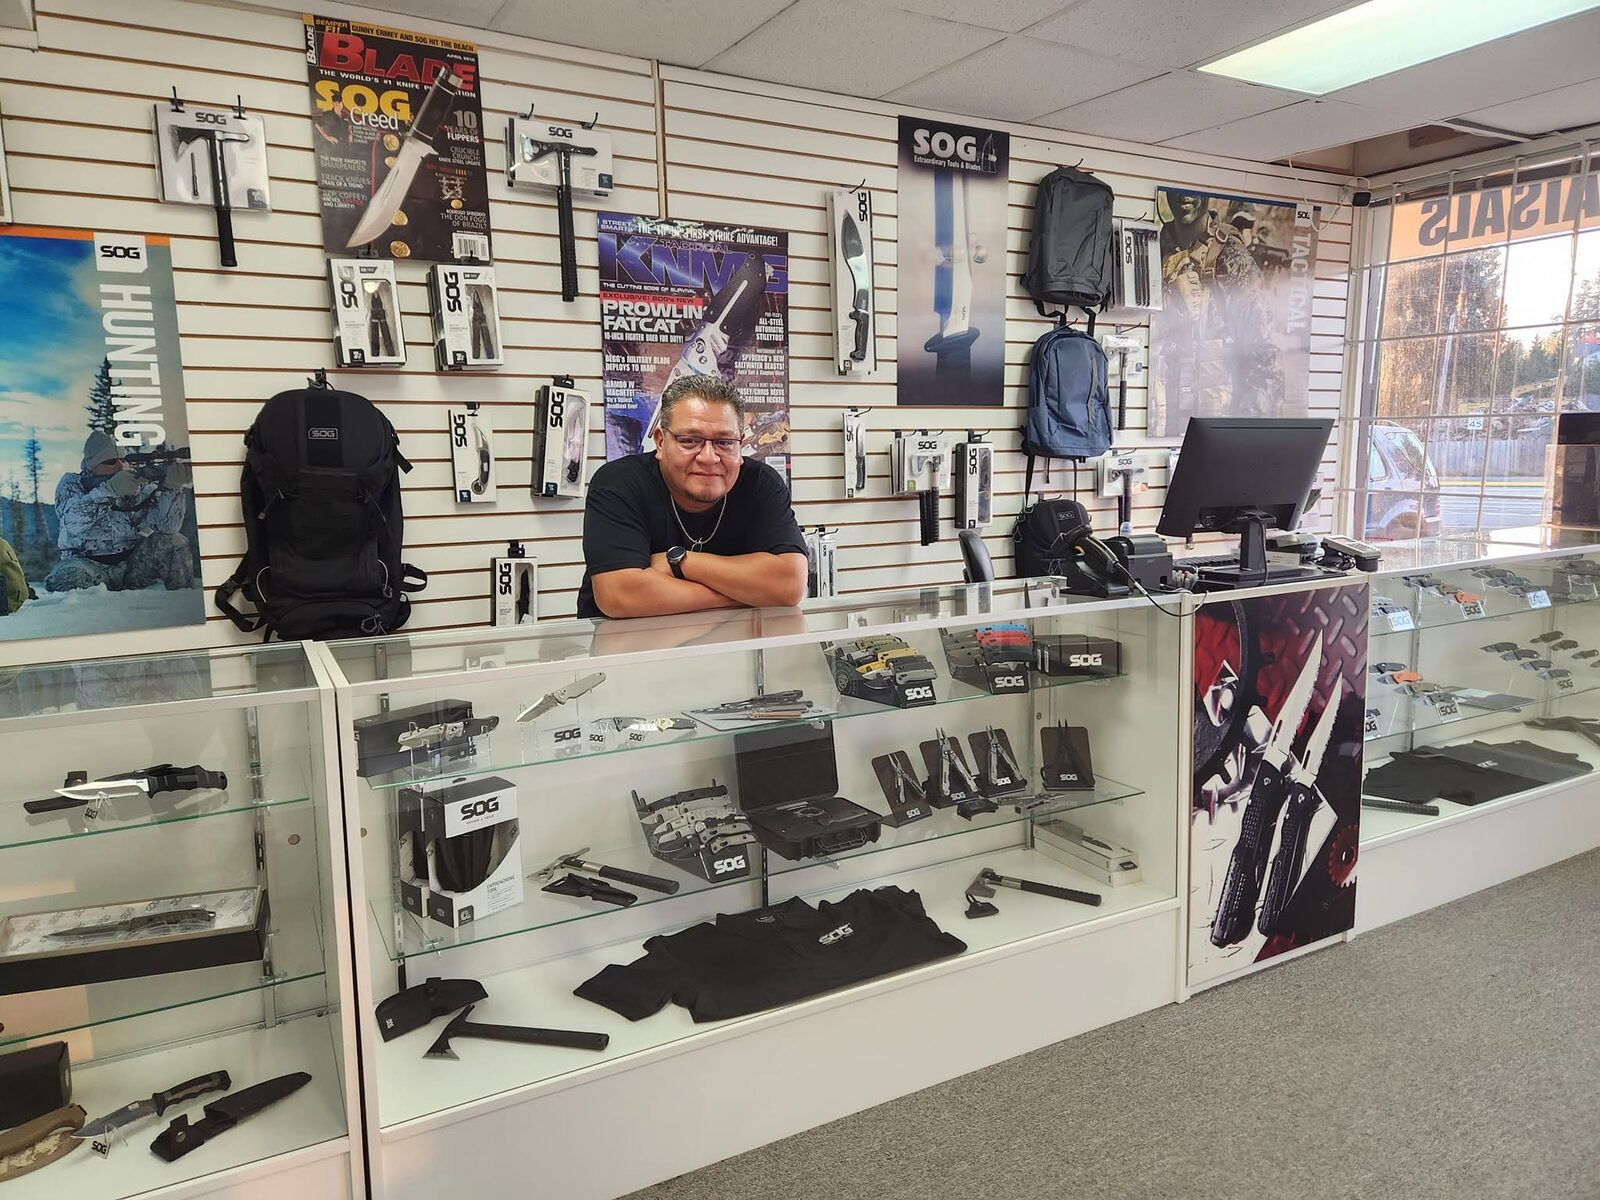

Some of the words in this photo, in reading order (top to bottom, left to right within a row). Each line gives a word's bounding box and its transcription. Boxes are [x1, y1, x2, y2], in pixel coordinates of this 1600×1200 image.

[315, 18, 348, 28] SEMPER
[307, 25, 317, 65] BLADE
[351, 25, 374, 34] GUNNY
[376, 29, 398, 38] ERMEY
[400, 33, 413, 41] AND
[415, 35, 428, 44] SOG
[429, 38, 439, 46] HIT
[440, 40, 452, 48] THE
[454, 43, 474, 51] BEACH
[320, 32, 476, 91] BLADE
[319, 69, 336, 77] THE
[340, 72, 379, 83] WORLD'S
[396, 81, 420, 90] KNIFE
[314, 80, 412, 121] SOG
[195, 112, 227, 125] SOG
[350, 106, 399, 131] Creed
[453, 110, 478, 128] 10
[447, 132, 480, 143] FLIPPERS
[548, 126, 573, 138] SOG
[913, 128, 977, 162] SOG
[913, 155, 946, 168] Extraordinary
[947, 160, 959, 168] Tools
[965, 162, 981, 171] Blades
[858, 192, 868, 222] SOG
[1297, 210, 1310, 220] SOG
[463, 221, 488, 229] BRAZIL?
[602, 219, 633, 227] STREET
[660, 239, 733, 254] TACTICAL
[736, 232, 778, 247] ADVANTAGE!
[100, 245, 140, 259] SOG
[1124, 236, 1133, 265] SOG
[337, 265, 359, 309] SOG
[1286, 232, 1312, 334] TACTICAL
[444, 271, 463, 313] SOG
[603, 292, 650, 301] EXCLUSIVE!
[603, 315, 680, 333] FATCAT
[758, 317, 784, 326] ALL-STEEL
[755, 325, 784, 333] AUTOMATIC
[756, 333, 784, 341] STILETTOS!
[99, 283, 166, 447] HUNTING
[734, 362, 763, 370] SALTWATER
[606, 388, 635, 397] MACHETE!
[550, 391, 565, 429] SOG
[453, 414, 468, 448] SOG
[1469, 420, 1482, 428] 45
[311, 429, 336, 438] SOG
[918, 441, 937, 450] SOG
[968, 448, 977, 476] SOG
[1118, 458, 1132, 466] SOG
[499, 562, 512, 596] SOG
[1464, 604, 1480, 616] SOG
[1069, 653, 1103, 668] SOG
[995, 675, 1025, 689] SOG
[1559, 679, 1574, 690] SOG
[905, 685, 933, 701] SOG
[1440, 703, 1458, 716] SOG
[1365, 720, 1378, 733] OG
[554, 727, 581, 743] SOG
[589, 734, 604, 742] SOG
[628, 732, 643, 742] SOG
[996, 776, 1012, 786] SOG
[1060, 773, 1079, 782] SOG
[950, 790, 966, 801] SOG
[460, 796, 500, 821] SOG
[906, 807, 922, 819] SOG
[713, 855, 747, 876] SOG
[818, 922, 855, 945] SOG
[92, 1140, 108, 1155] SOG
